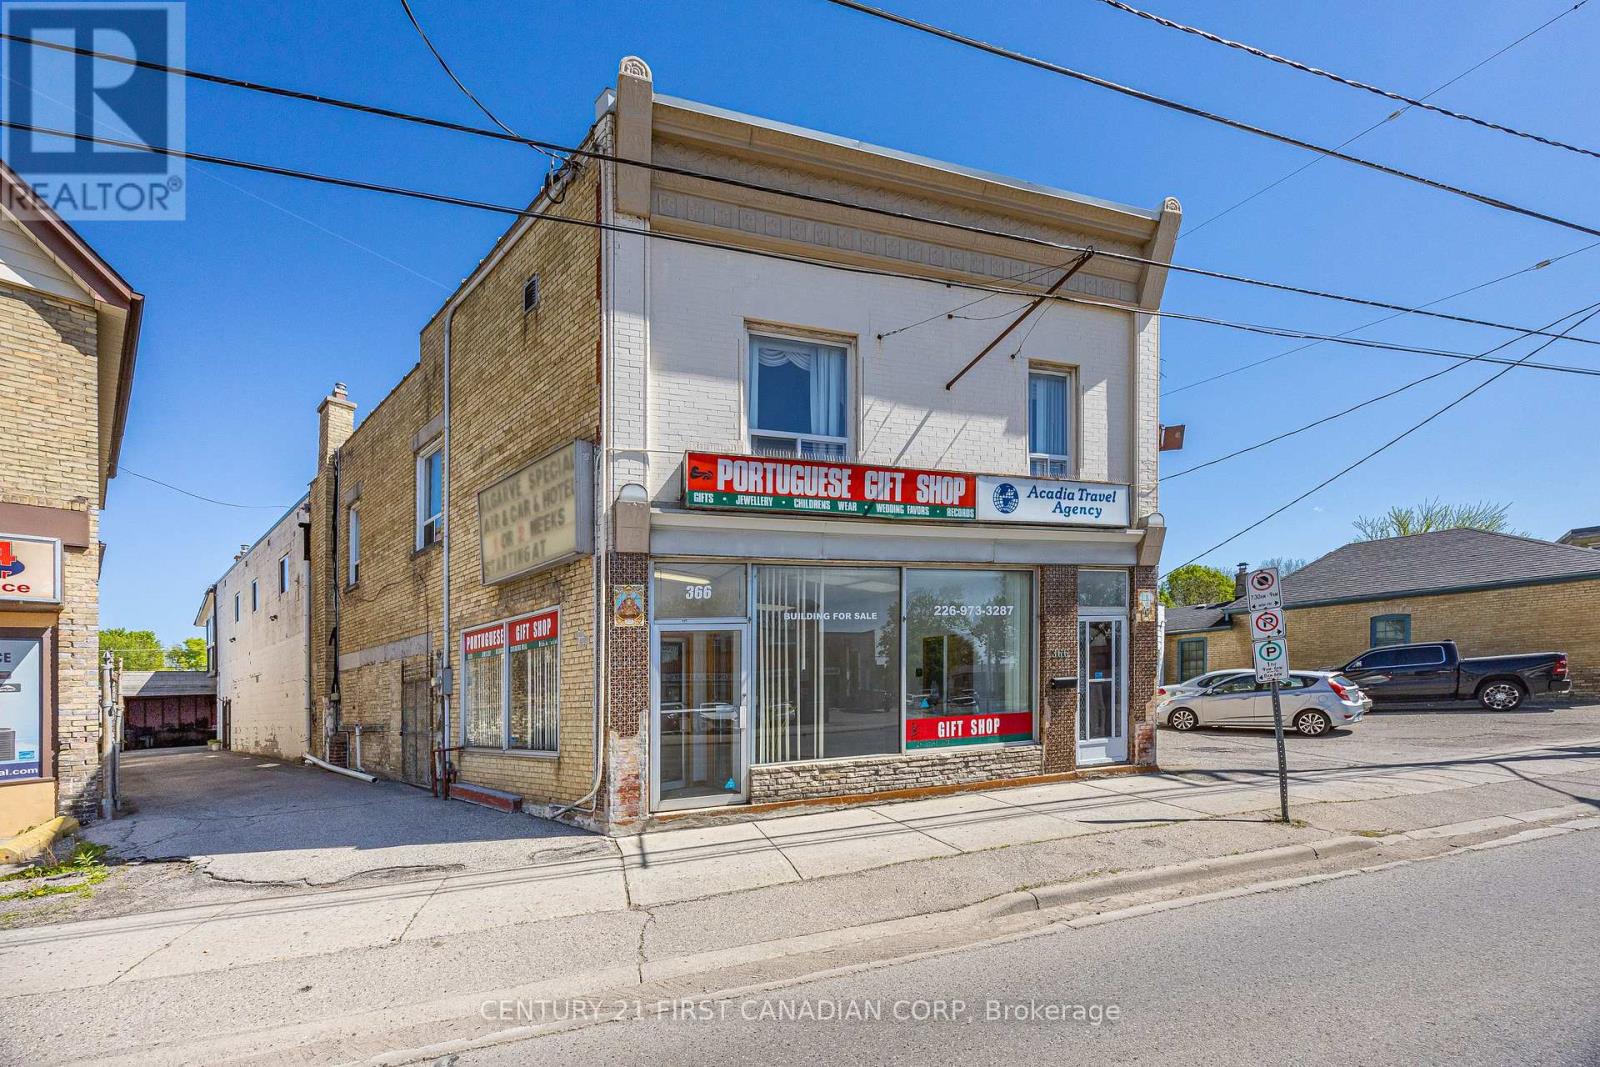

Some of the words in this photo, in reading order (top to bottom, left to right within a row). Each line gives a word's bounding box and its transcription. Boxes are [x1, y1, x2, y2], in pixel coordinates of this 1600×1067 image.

[717, 458, 851, 498] PORTUGUESE
[864, 470, 905, 502] GIFT
[916, 474, 966, 504] SHOP
[1027, 485, 1075, 501] Acadia
[1078, 488, 1116, 503] Travel
[693, 492, 714, 503] GIFTS
[735, 494, 773, 507] JEWELLERY
[794, 498, 830, 510] CHILDRENS
[838, 500, 857, 512] WEAR
[876, 503, 906, 514] WEDDING
[907, 505, 929, 516] FAVORS
[946, 507, 975, 518] RECORDS
[1052, 501, 1103, 518] Agency
[686, 585, 712, 600] 366
[784, 612, 830, 620] BUILDING
[833, 612, 852, 620] FOR
[854, 612, 878, 620] SALE
[934, 605, 1014, 616] 226-973-3287
[466, 629, 504, 651] PORTUGUESE
[515, 623, 530, 641] GIFT
[533, 618, 551, 638] SHOP
[938, 720, 963, 738] GIFT
[970, 718, 1000, 735] SHOP
